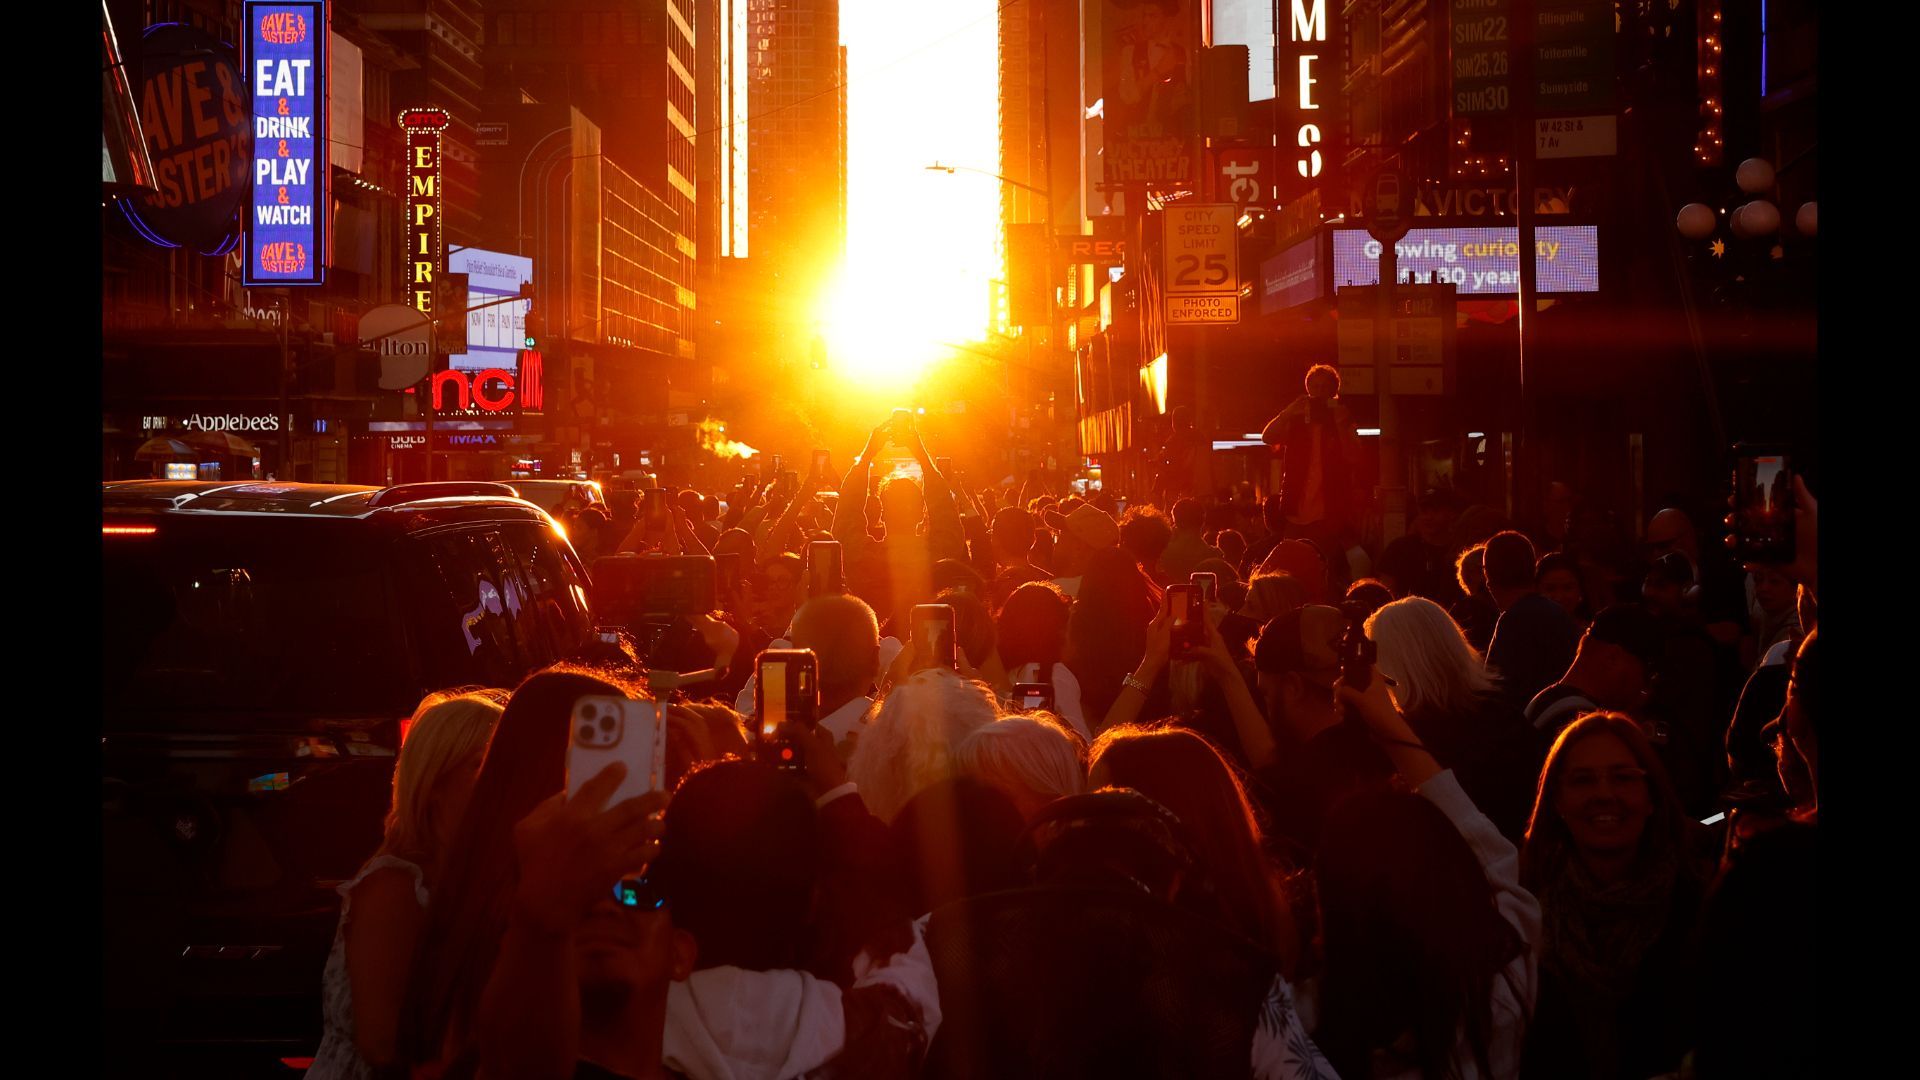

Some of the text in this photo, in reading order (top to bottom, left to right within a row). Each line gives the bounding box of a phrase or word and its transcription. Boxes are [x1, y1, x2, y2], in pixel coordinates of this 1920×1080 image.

[297, 14, 306, 31] &
[1455, 15, 1508, 44] SIM22
[1456, 50, 1509, 79] SIM25,26
[256, 59, 311, 97] EAT
[143, 61, 218, 151] AVE
[277, 97, 290, 115] &
[1456, 85, 1509, 113] SIM30
[256, 116, 311, 138] DRINK
[405, 113, 446, 127] amc
[1539, 122, 1549, 133] W
[1551, 121, 1563, 133] 42
[1564, 121, 1574, 132] St
[277, 139, 290, 158] &
[1539, 137, 1560, 148] 7 Av
[145, 129, 247, 208] STER'S
[256, 158, 311, 185] PLAY
[277, 186, 290, 204] &
[256, 205, 311, 225] WATCH
[1184, 210, 1214, 223] CITY
[411, 146, 436, 314] EMPIRE
[1178, 224, 1221, 236] SPEED
[297, 243, 306, 261] &
[1183, 238, 1217, 250] LIMIT
[1363, 239, 1559, 263] Gowing curioty
[1174, 254, 1230, 286] 25
[1183, 298, 1221, 309] PHOTO
[1172, 308, 1233, 319] ENFORCED
[187, 413, 279, 432] Applebee's
